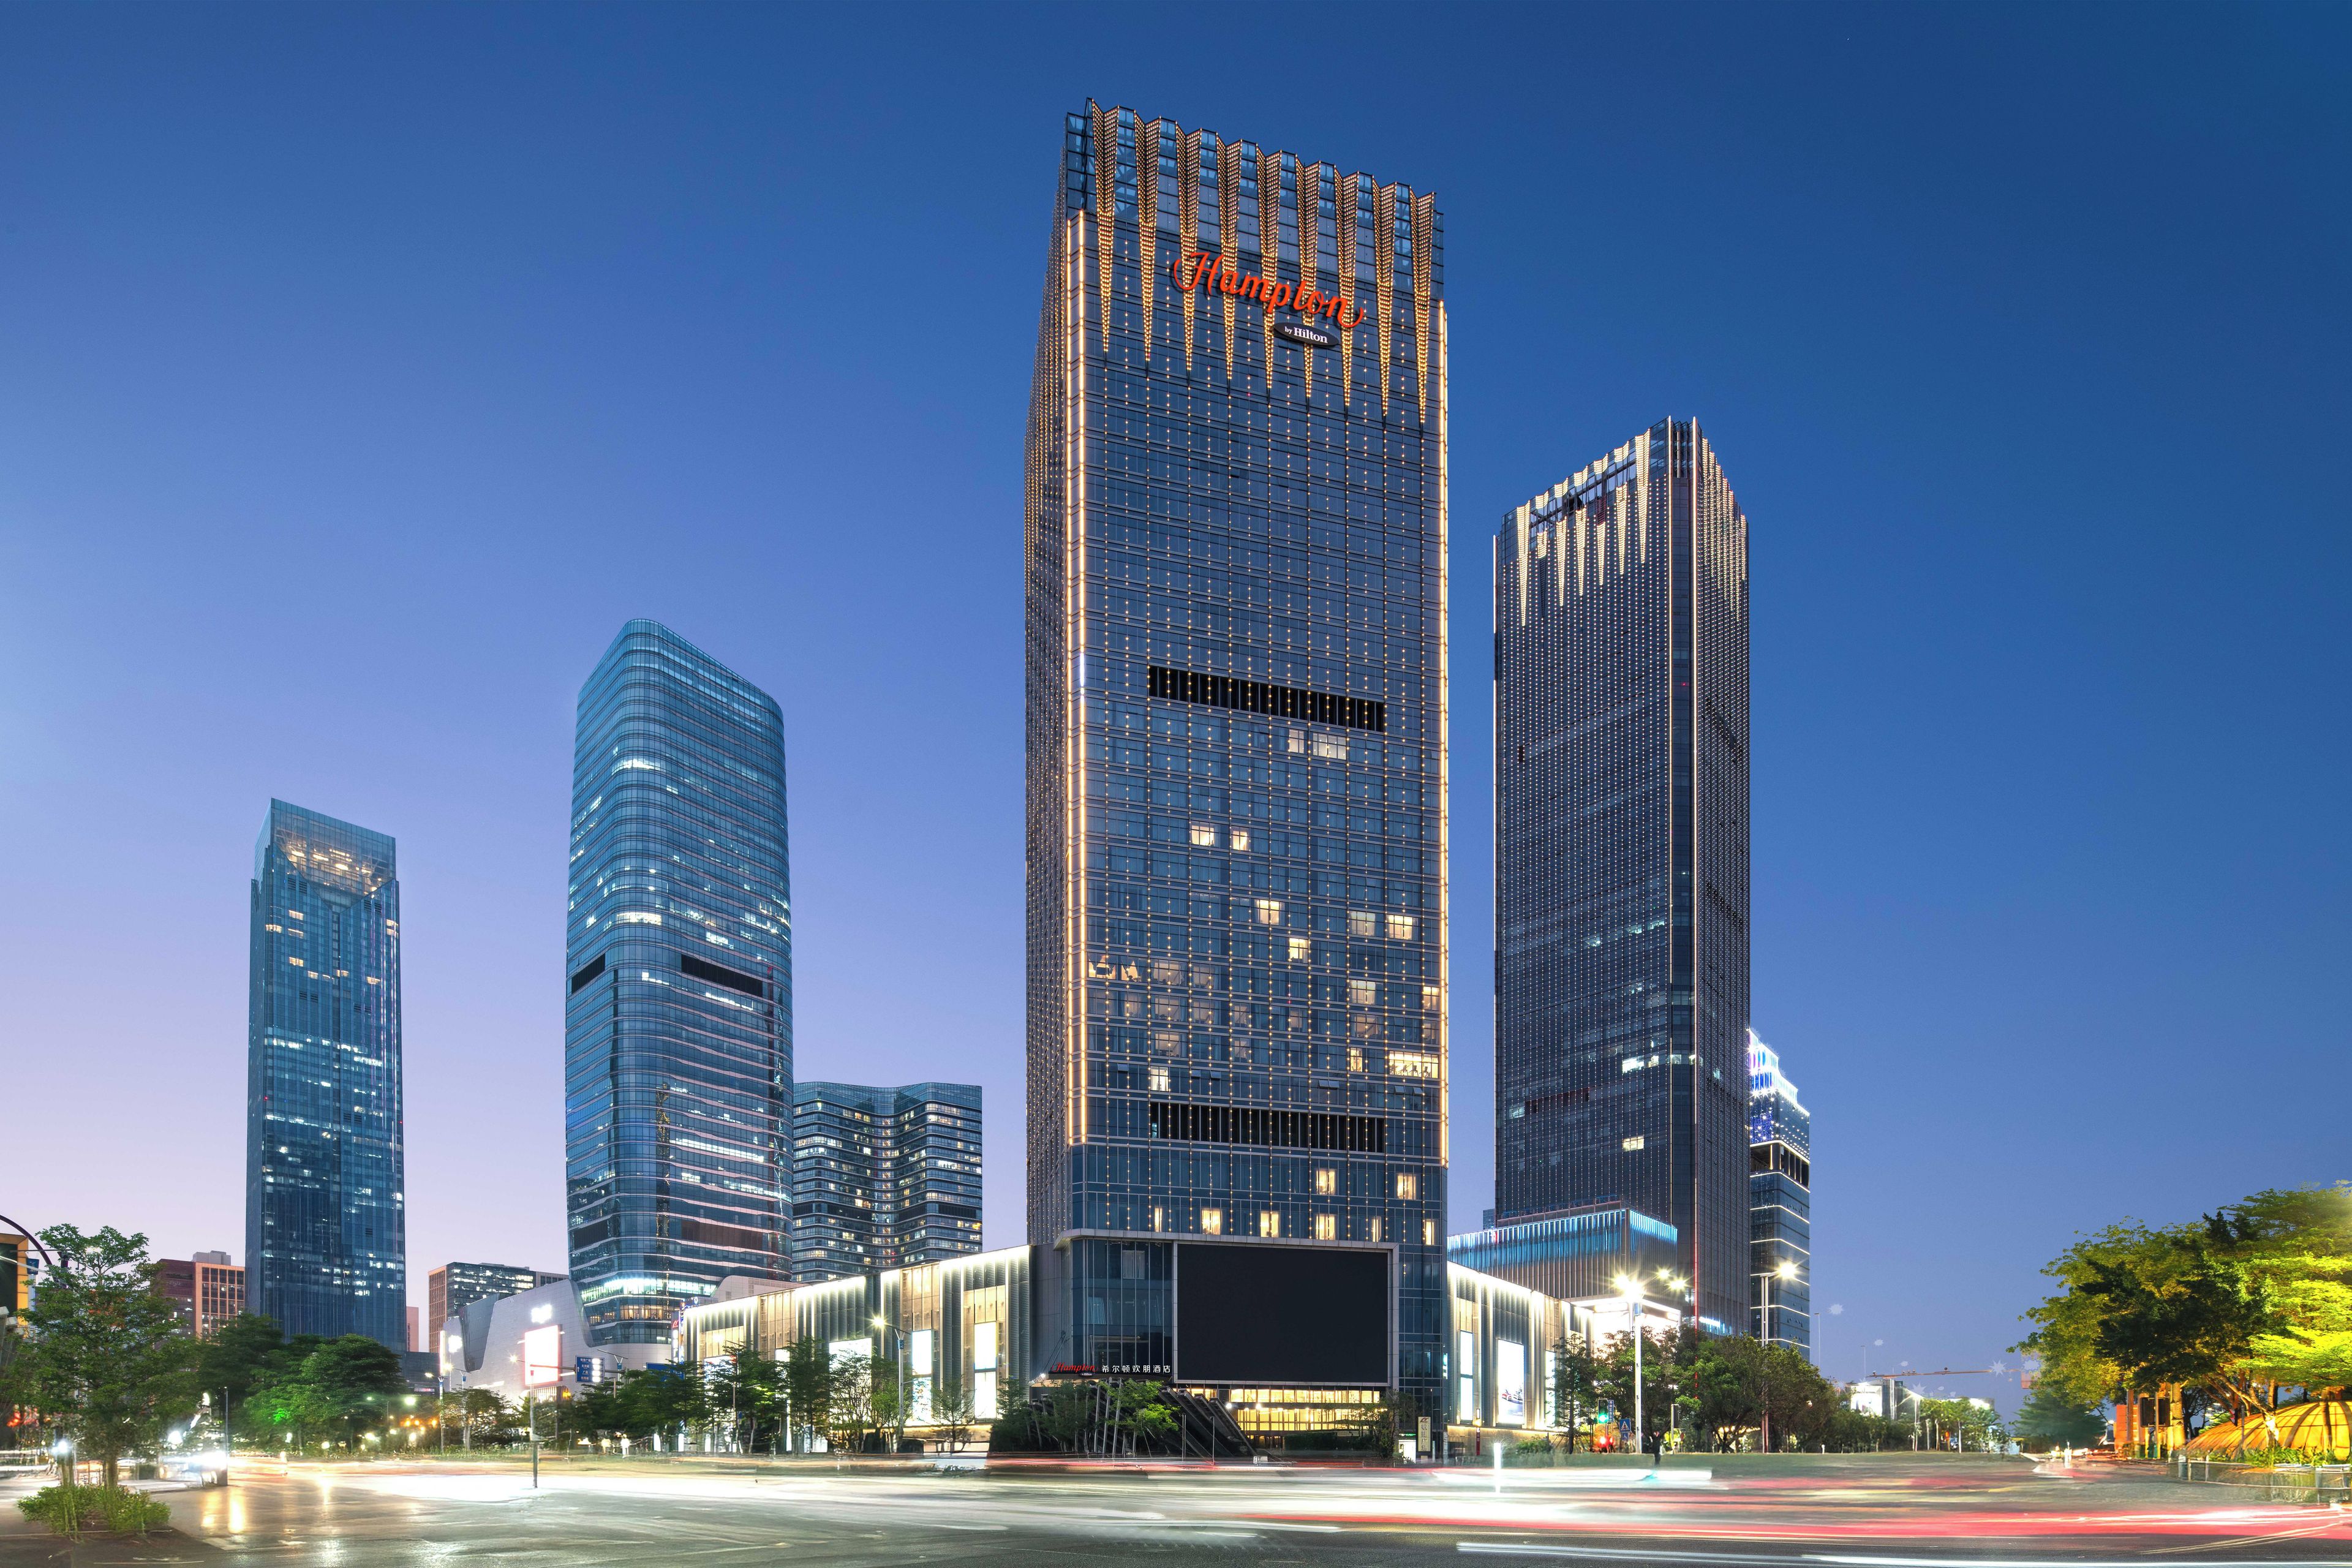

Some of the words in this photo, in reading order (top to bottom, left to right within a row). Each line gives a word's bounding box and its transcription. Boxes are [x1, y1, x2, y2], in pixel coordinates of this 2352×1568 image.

[1173, 252, 1364, 328] Hampton
[1284, 326, 1293, 334] by
[1294, 326, 1328, 344] Hilton
[1101, 1365, 1170, 1373] 希尔顿欢朋酒店
